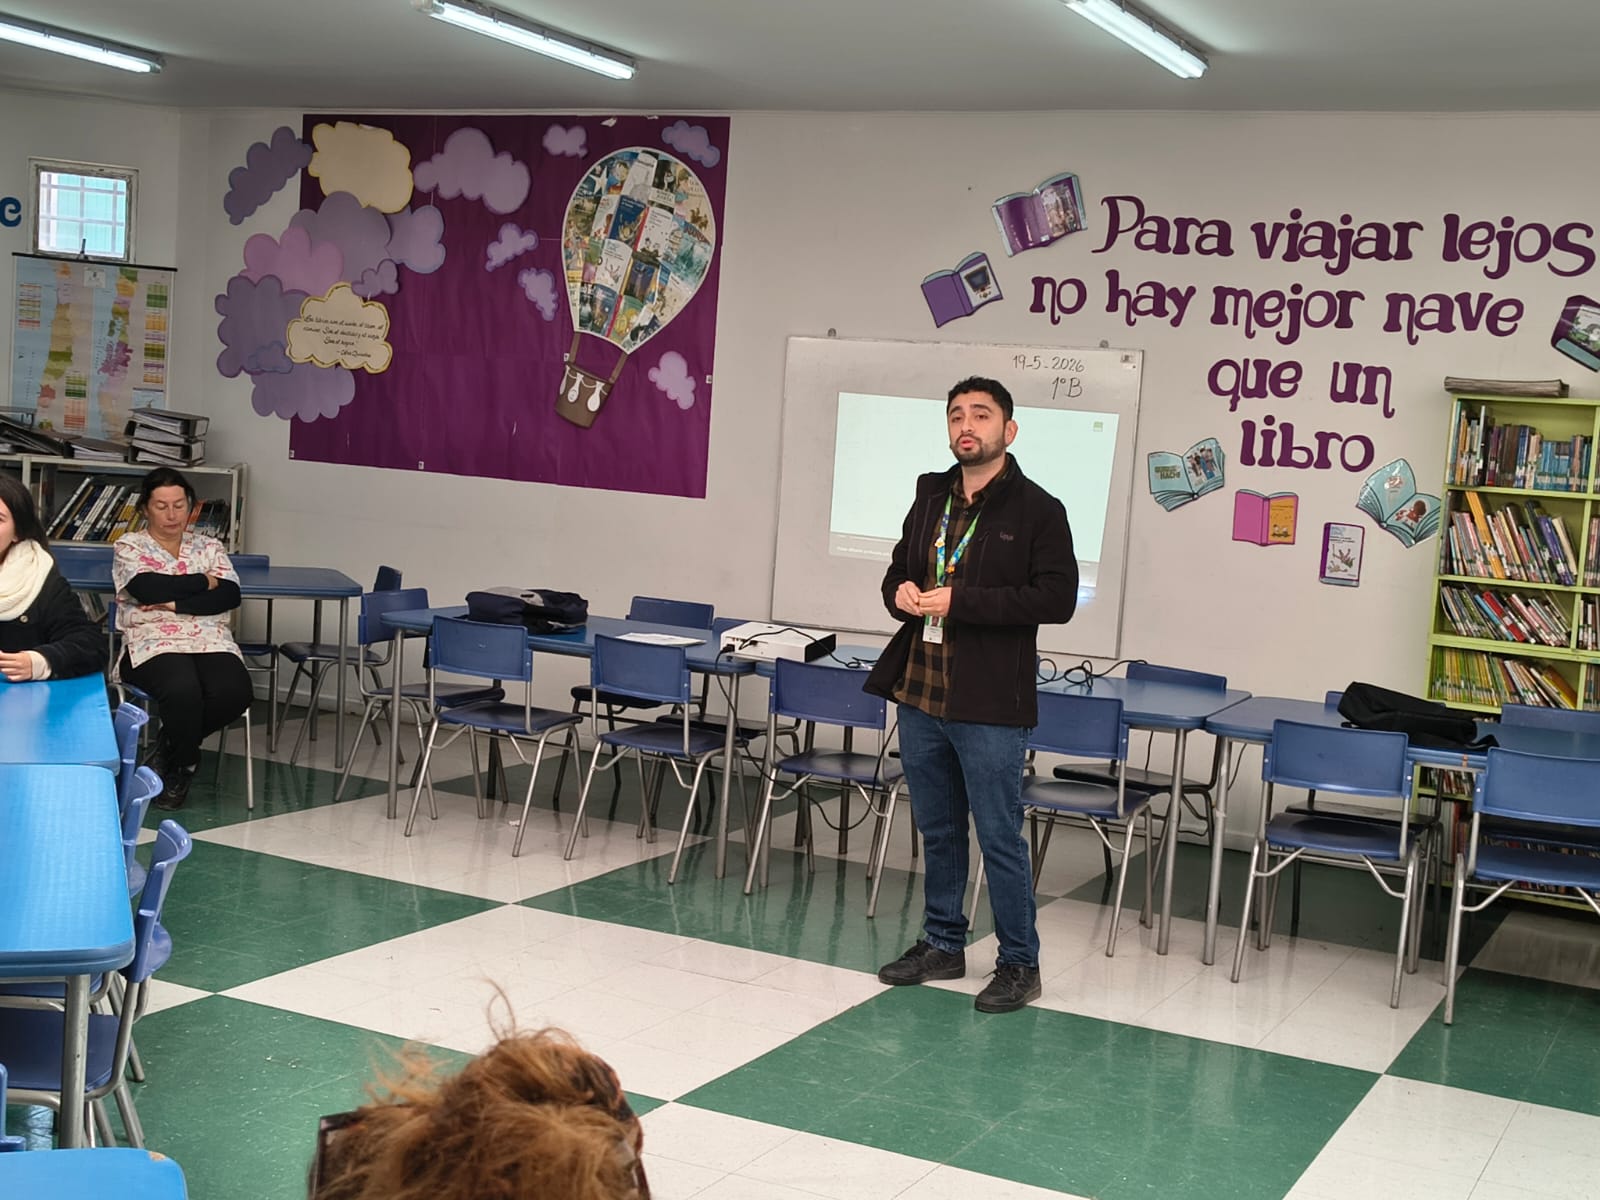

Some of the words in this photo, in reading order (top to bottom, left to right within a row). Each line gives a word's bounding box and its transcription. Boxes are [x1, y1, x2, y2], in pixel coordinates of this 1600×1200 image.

[1091, 194, 1233, 257] Para
[1249, 208, 1425, 276] viajar
[1442, 213, 1598, 280] lejos
[1029, 274, 1088, 326] no
[1104, 269, 1197, 328] hay
[1210, 282, 1366, 346] mejor
[1383, 291, 1526, 347] nave
[1207, 358, 1303, 414] que
[1330, 361, 1397, 419] un
[1239, 414, 1376, 473] libro
